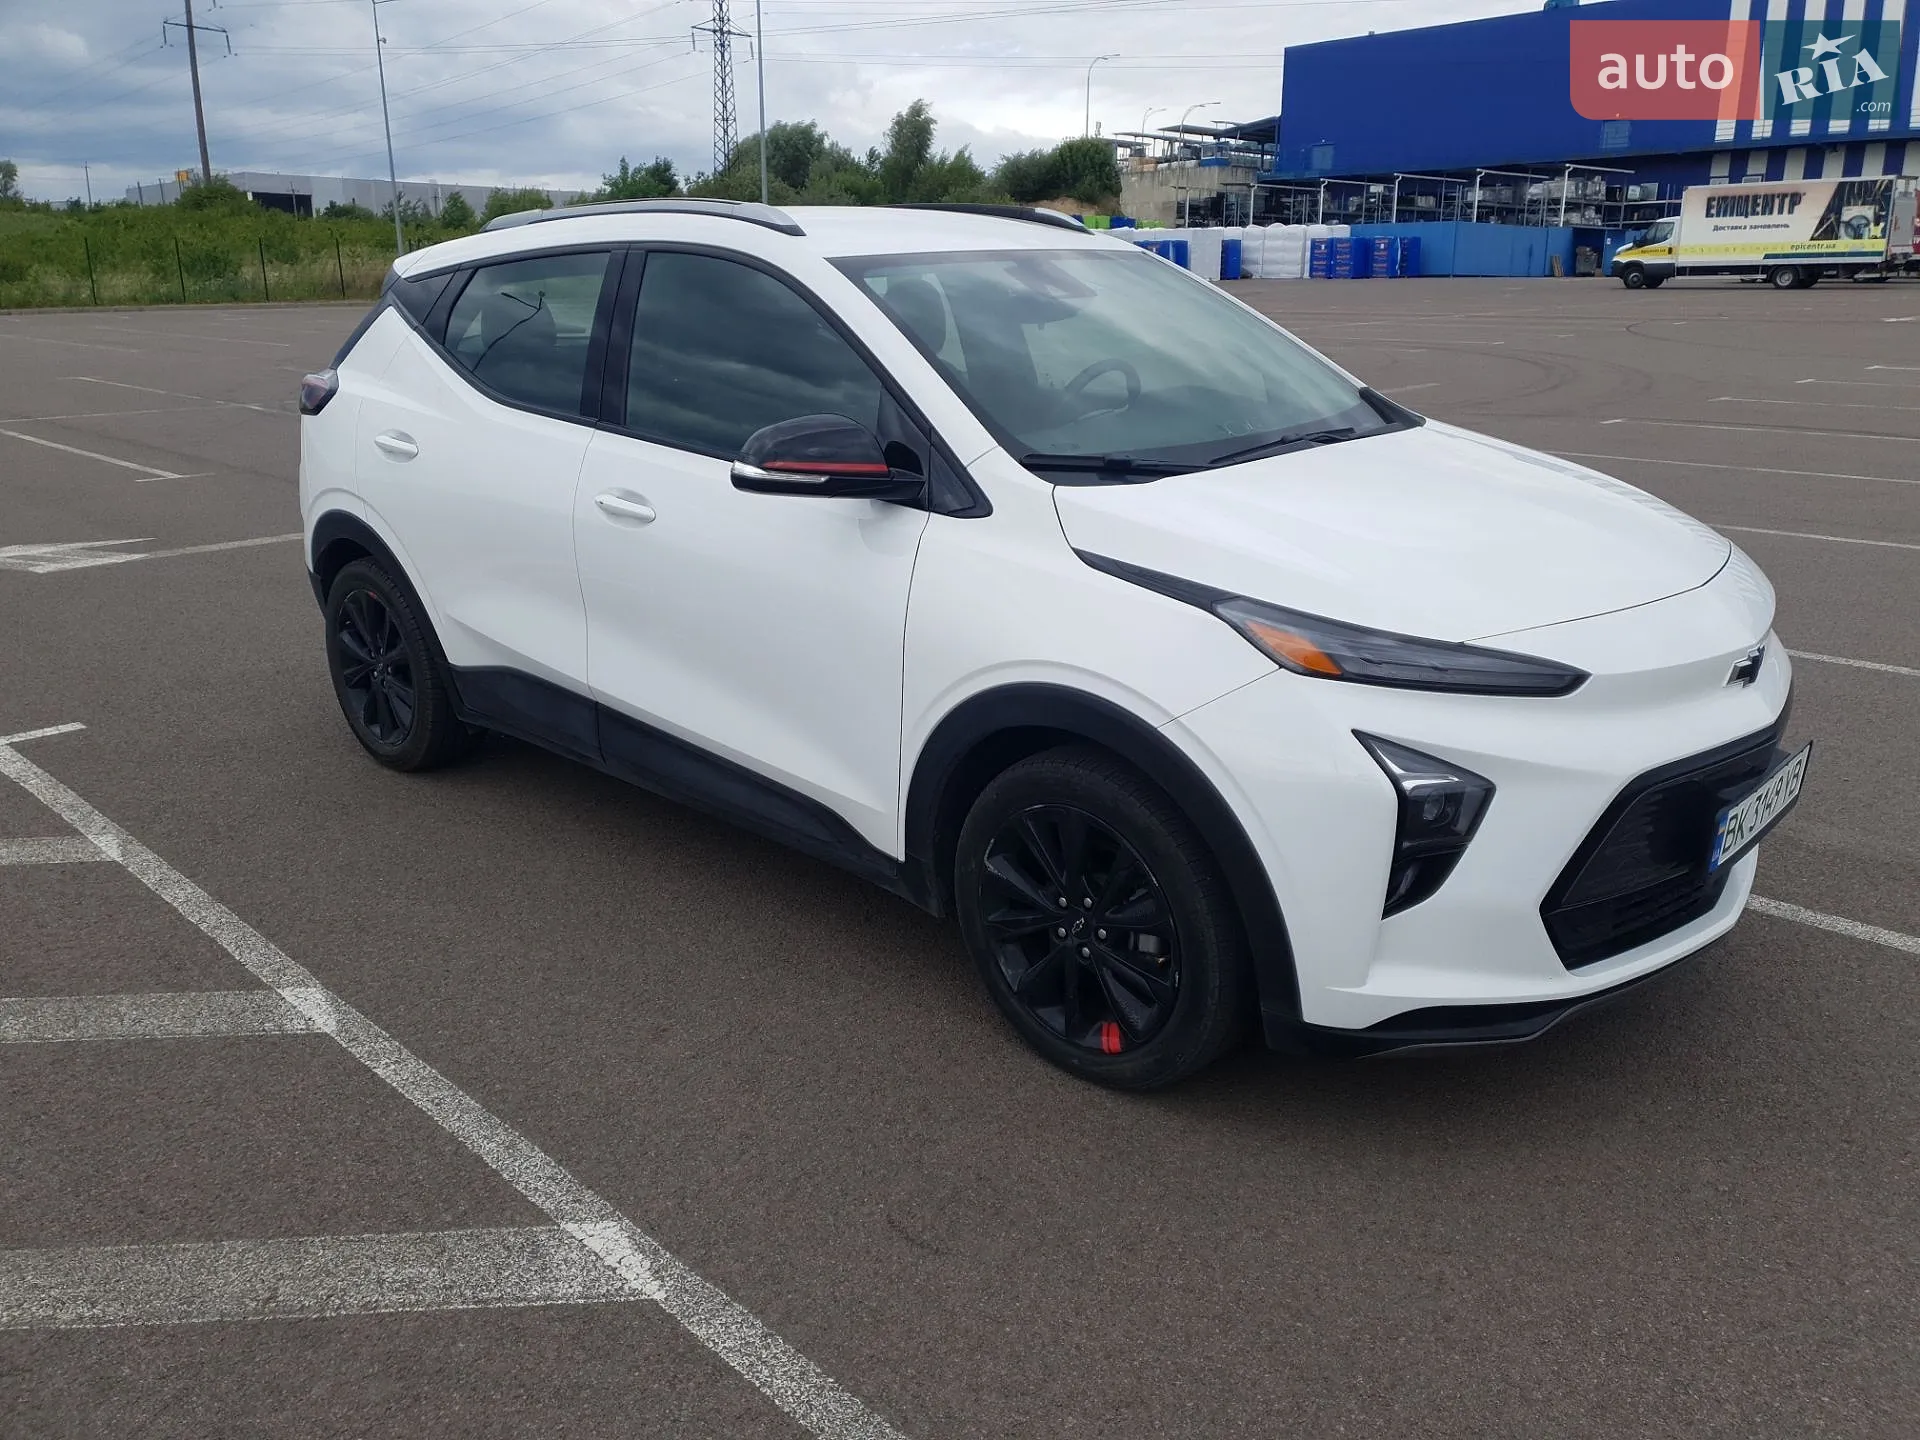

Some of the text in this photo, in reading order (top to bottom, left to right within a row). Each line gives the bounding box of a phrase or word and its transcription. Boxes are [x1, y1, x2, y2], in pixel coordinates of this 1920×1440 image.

[1712, 223, 1790, 232] Доставка замовлень
[1790, 242, 1836, 251] epicentr.ua
[1721, 801, 1753, 855] BK
[1749, 775, 1784, 832] 3149
